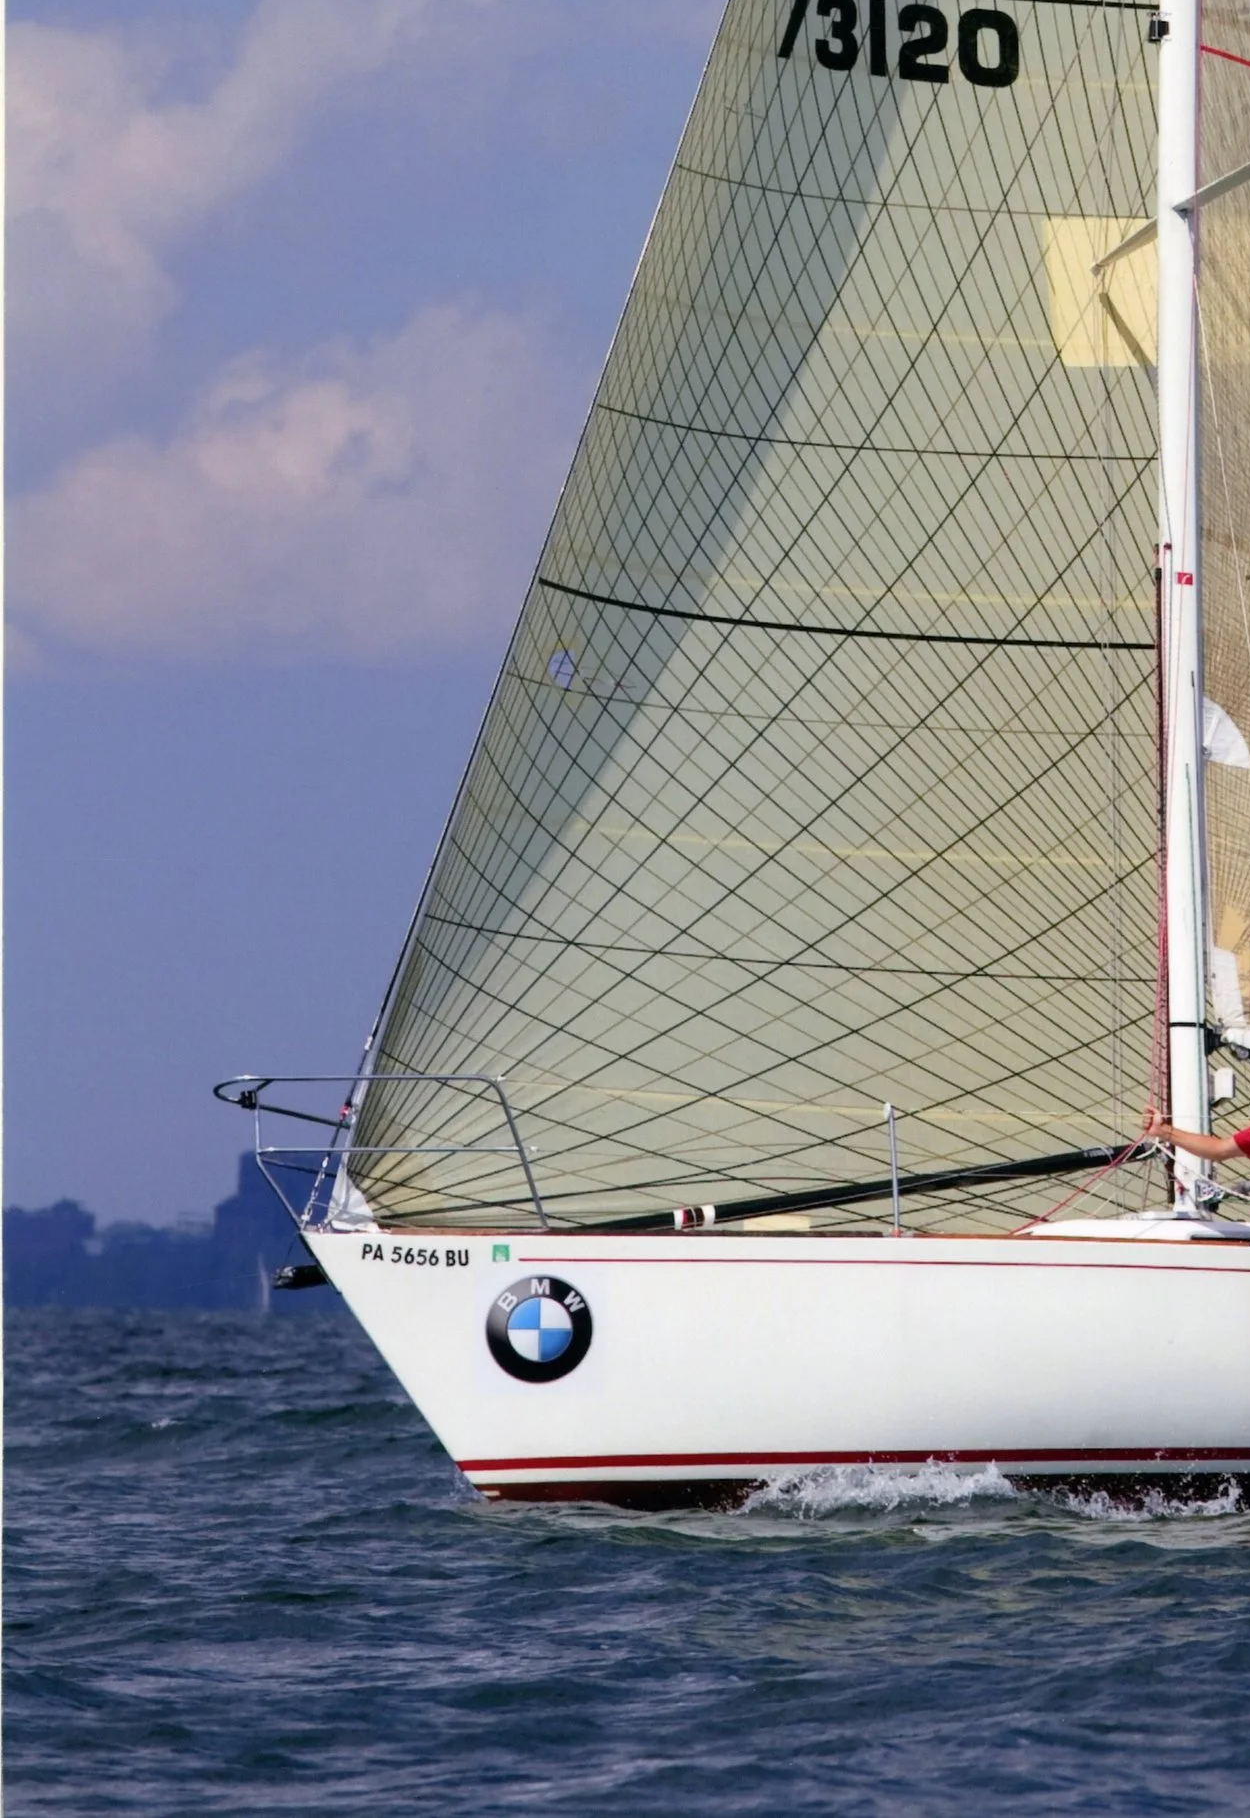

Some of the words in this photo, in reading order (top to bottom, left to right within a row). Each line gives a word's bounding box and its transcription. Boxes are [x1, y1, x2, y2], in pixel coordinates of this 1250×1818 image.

[361, 1243, 384, 1261] PA
[391, 1246, 439, 1266] 5656
[445, 1249, 469, 1267] BU
[497, 1278, 585, 1313] BMW
